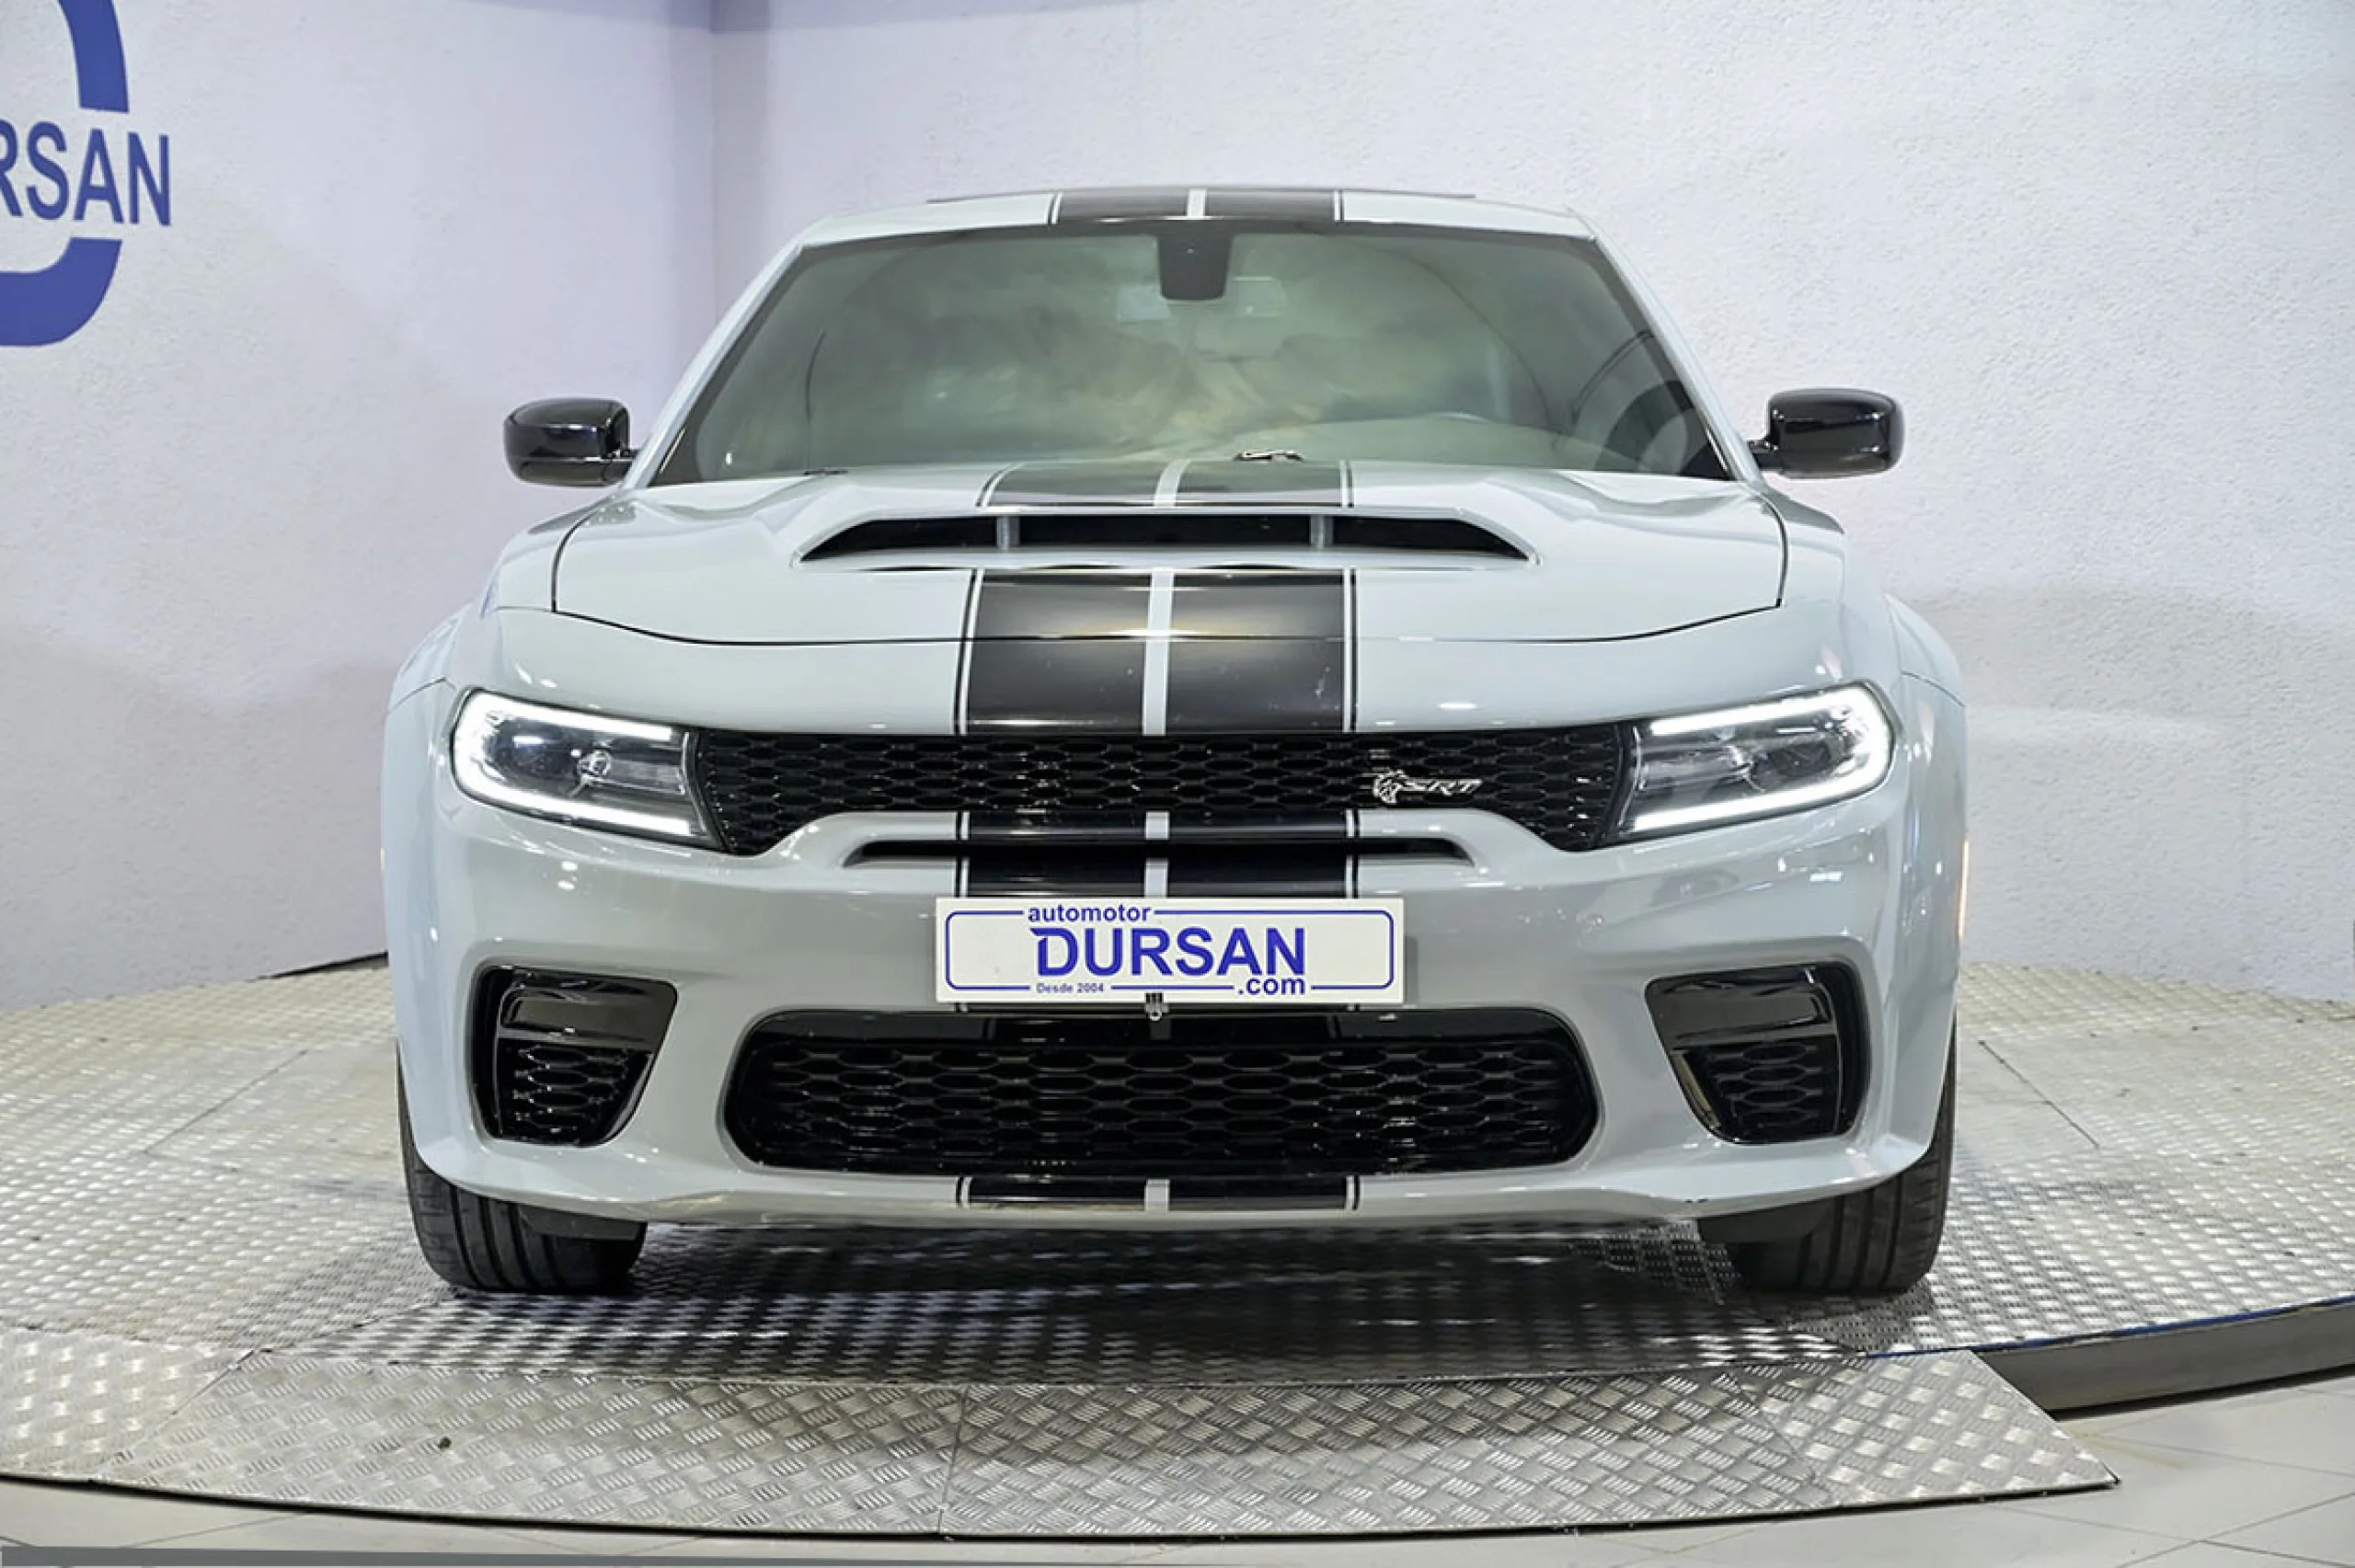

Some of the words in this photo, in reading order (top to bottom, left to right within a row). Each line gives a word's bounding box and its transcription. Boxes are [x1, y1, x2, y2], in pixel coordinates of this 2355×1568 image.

[1028, 904, 1152, 922] automotor
[1029, 927, 1304, 975] DURSAN
[1036, 983, 1073, 993] Desde
[1077, 983, 1104, 993] 2004
[1237, 978, 1305, 995] .com
